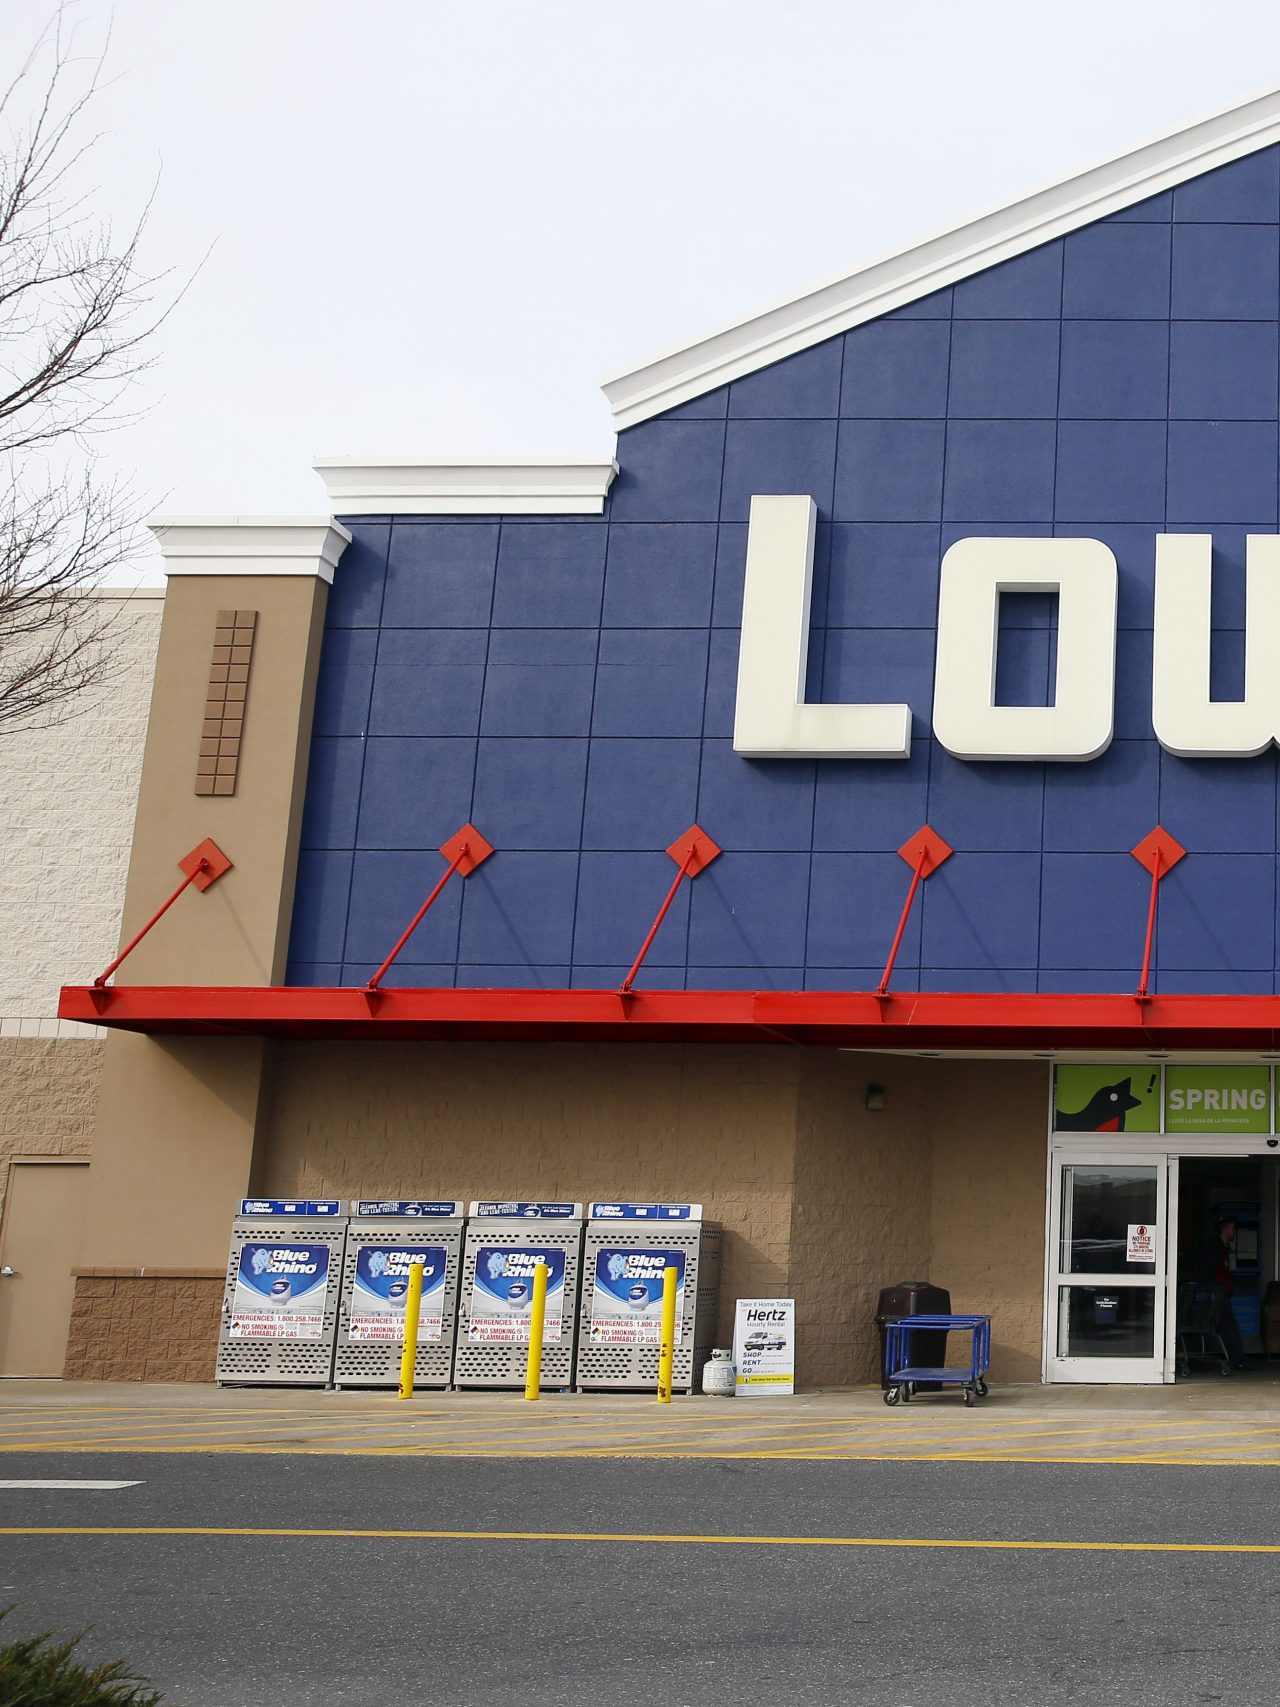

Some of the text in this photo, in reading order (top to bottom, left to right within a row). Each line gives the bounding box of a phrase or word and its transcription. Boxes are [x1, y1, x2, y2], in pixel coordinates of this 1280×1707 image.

[1169, 1089, 1266, 1110] SPRING
[272, 1249, 310, 1261] Blue
[389, 1252, 427, 1264] Blue
[508, 1253, 546, 1264] Blue
[628, 1255, 666, 1266] Blue
[266, 1262, 317, 1274] Rhino
[382, 1264, 434, 1276] Rhio
[622, 1267, 665, 1279] Rhin
[747, 1309, 786, 1321] Hertz
